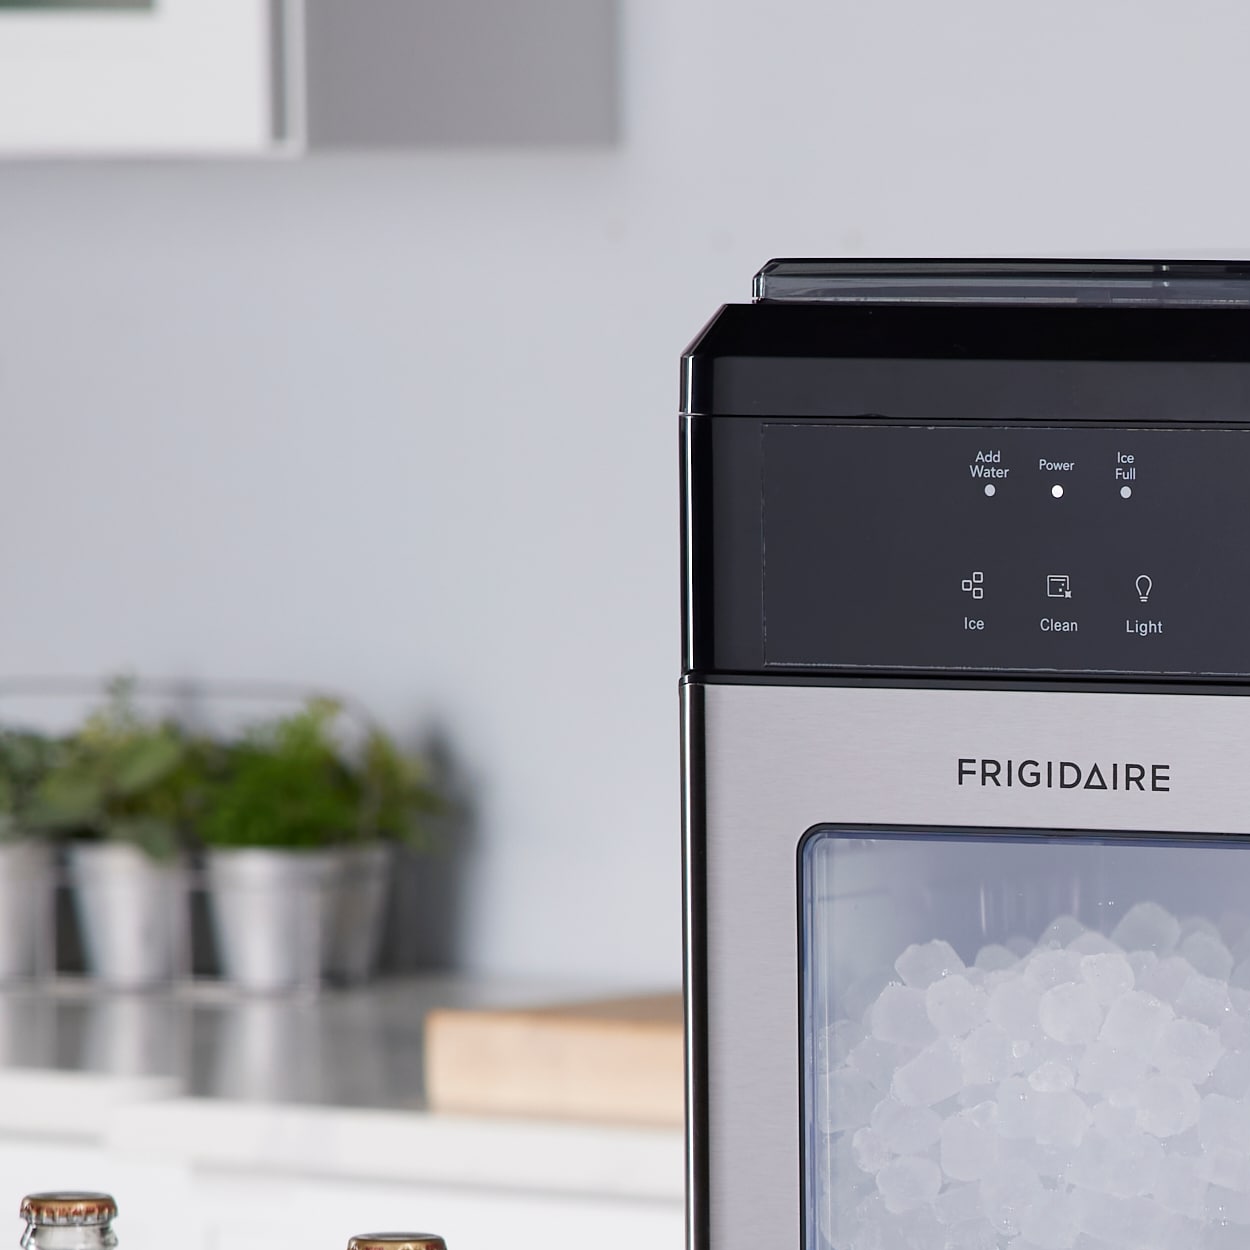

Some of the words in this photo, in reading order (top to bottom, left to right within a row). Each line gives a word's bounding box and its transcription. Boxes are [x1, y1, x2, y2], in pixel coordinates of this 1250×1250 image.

[975, 450, 1001, 463] Add
[1118, 452, 1135, 463] Ice
[1040, 458, 1075, 471] Power
[970, 465, 1009, 478] Water
[1116, 468, 1136, 480] Full
[965, 617, 985, 630] Ice
[1040, 618, 1078, 632] Clean
[1127, 620, 1163, 636] Light
[958, 759, 1170, 792] FRIGIDAIRE
